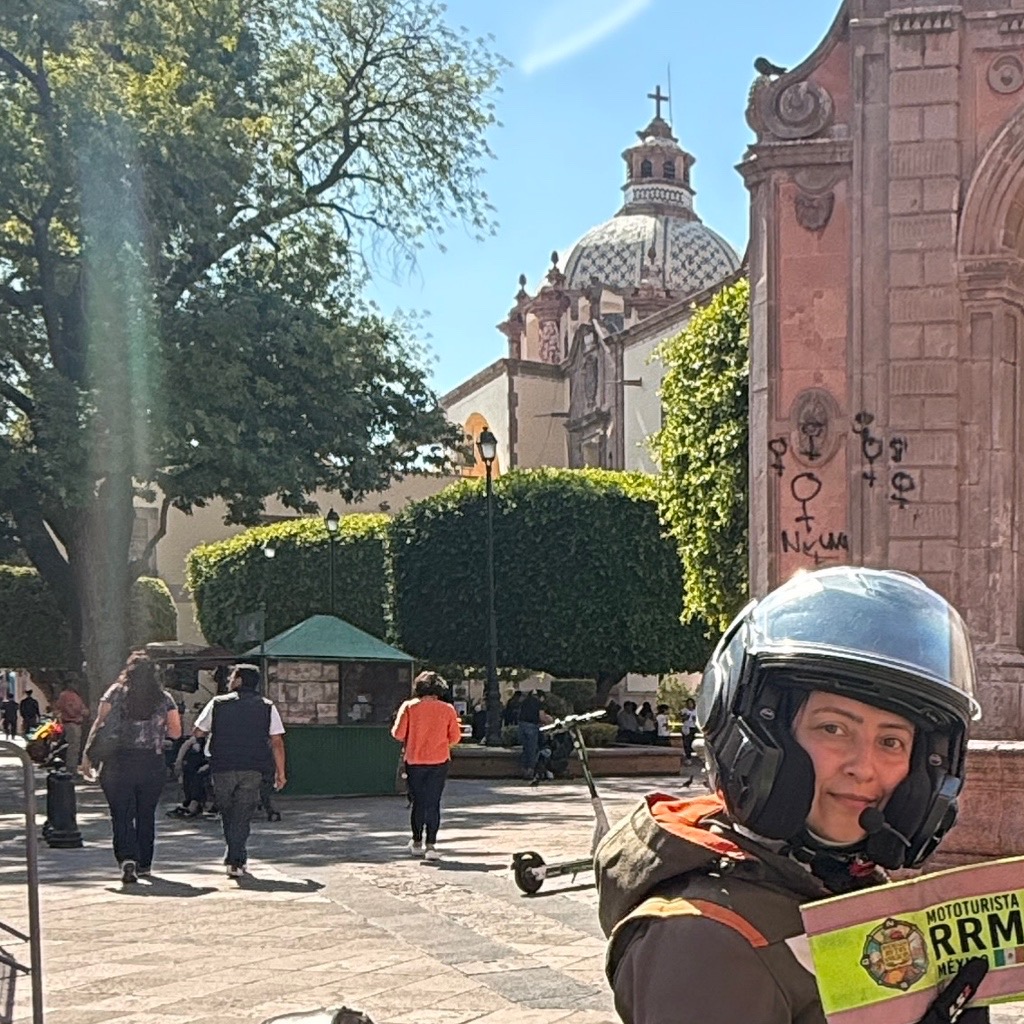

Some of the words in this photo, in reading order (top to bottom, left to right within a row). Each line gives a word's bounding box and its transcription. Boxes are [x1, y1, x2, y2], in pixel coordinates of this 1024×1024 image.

[925, 893, 1020, 925] MOTOTURISTA
[929, 910, 1024, 960] RRM
[937, 954, 989, 978] MÉX
